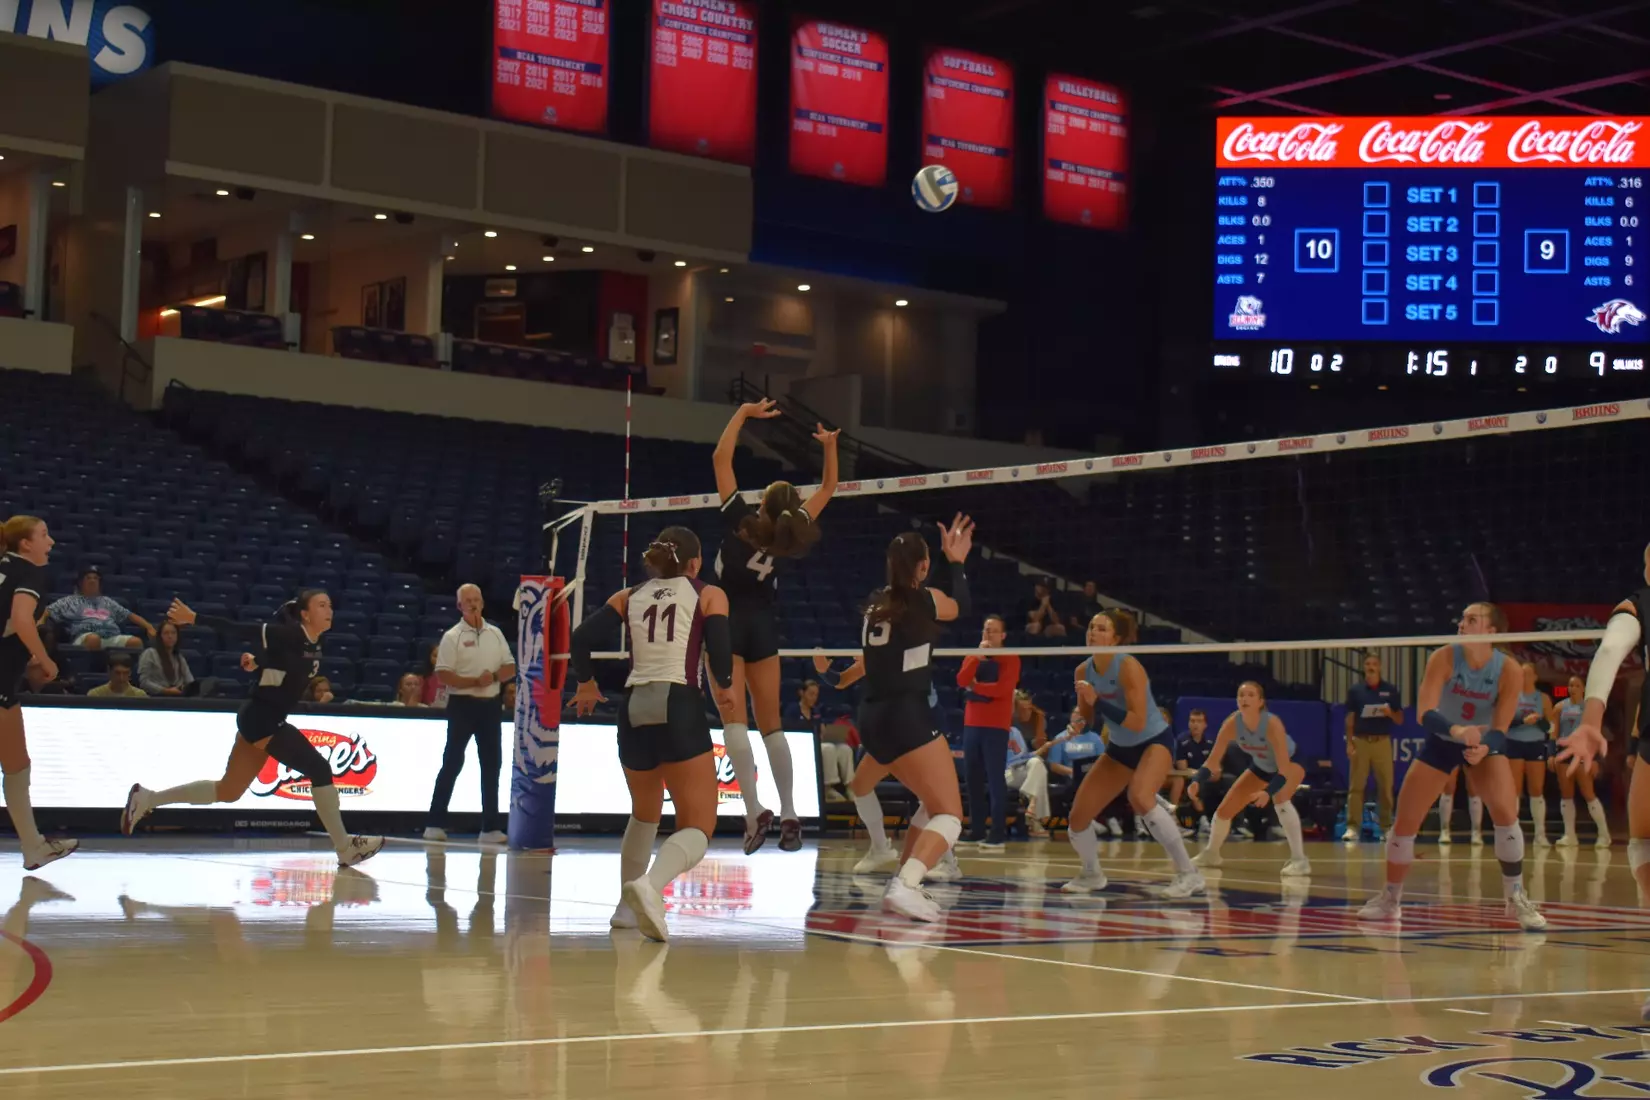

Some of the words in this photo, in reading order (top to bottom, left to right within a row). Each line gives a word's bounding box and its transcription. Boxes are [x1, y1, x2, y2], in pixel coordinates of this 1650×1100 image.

[661, 1, 697, 20] CROSS
[701, 9, 754, 31] COUNTRY
[817, 23, 868, 43] WOMEN'S
[822, 36, 862, 55] SOCCER
[516, 51, 535, 62] NCAA
[538, 55, 586, 71] TOURNAMENT
[943, 55, 995, 76] SOFTBALL
[1058, 80, 1119, 104] VOLLEYBALL
[1223, 122, 1345, 162] Coca-Cola
[1358, 120, 1493, 163] Coca-Cola
[1507, 120, 1643, 163] Coca-Cola
[1219, 176, 1247, 187] ATT%
[1250, 176, 1275, 188] .350
[1585, 176, 1613, 187] ATT%
[1617, 177, 1642, 189] .316
[1219, 196, 1248, 206] KILLS
[1257, 195, 1266, 207] 8
[1407, 187, 1443, 203] SET
[1448, 187, 1457, 203] 1
[1585, 197, 1615, 207] KILLS
[1625, 196, 1634, 208] 6
[1218, 215, 1246, 226] BLKS
[1252, 215, 1271, 227] 0.0
[1406, 217, 1443, 232] SET
[1447, 217, 1459, 232] 2
[1585, 217, 1613, 227] BLKS
[1620, 216, 1639, 228] 0.0
[1217, 235, 1246, 245] ACES
[1257, 234, 1265, 246] 1
[1306, 239, 1332, 259] 10
[1584, 236, 1612, 247] ACES
[1625, 236, 1633, 247] 1
[1406, 246, 1443, 262] SET
[1446, 246, 1459, 262] 3
[1540, 240, 1555, 260] 9
[1217, 255, 1243, 265] DIGS
[1254, 254, 1269, 265] 12
[1584, 256, 1610, 267] DIGS
[1624, 255, 1633, 267] 9
[1217, 274, 1244, 285] ASTS
[1256, 273, 1265, 284] 7
[1405, 275, 1442, 291] SET
[1445, 275, 1458, 291] 4
[1584, 276, 1612, 287] ASTS
[1624, 275, 1633, 286] 6
[1405, 305, 1442, 321] SET
[1445, 305, 1458, 321] 5
[1270, 348, 1294, 375] 10
[1310, 354, 1324, 372] 0
[1330, 354, 1344, 372] 2
[1406, 350, 1448, 376] 1:15
[1470, 360, 1477, 376] 1
[1515, 355, 1528, 373] 2
[1545, 356, 1558, 374] 0
[1589, 351, 1606, 376] 9
[1036, 462, 1068, 476] BRUINS
[1111, 455, 1143, 468] BELMONT
[1191, 446, 1226, 460] BRUINS
[1278, 437, 1314, 451] BELMONT
[1368, 426, 1409, 442] BRUINS
[1467, 415, 1509, 431] BELMONT
[1572, 403, 1621, 420] BRUINS
[746, 549, 775, 583] 4
[642, 603, 677, 643] 11
[307, 659, 320, 679] 3
[1461, 701, 1476, 721] 9
[308, 732, 338, 747] ising
[1236, 1034, 1503, 1069] RICK
